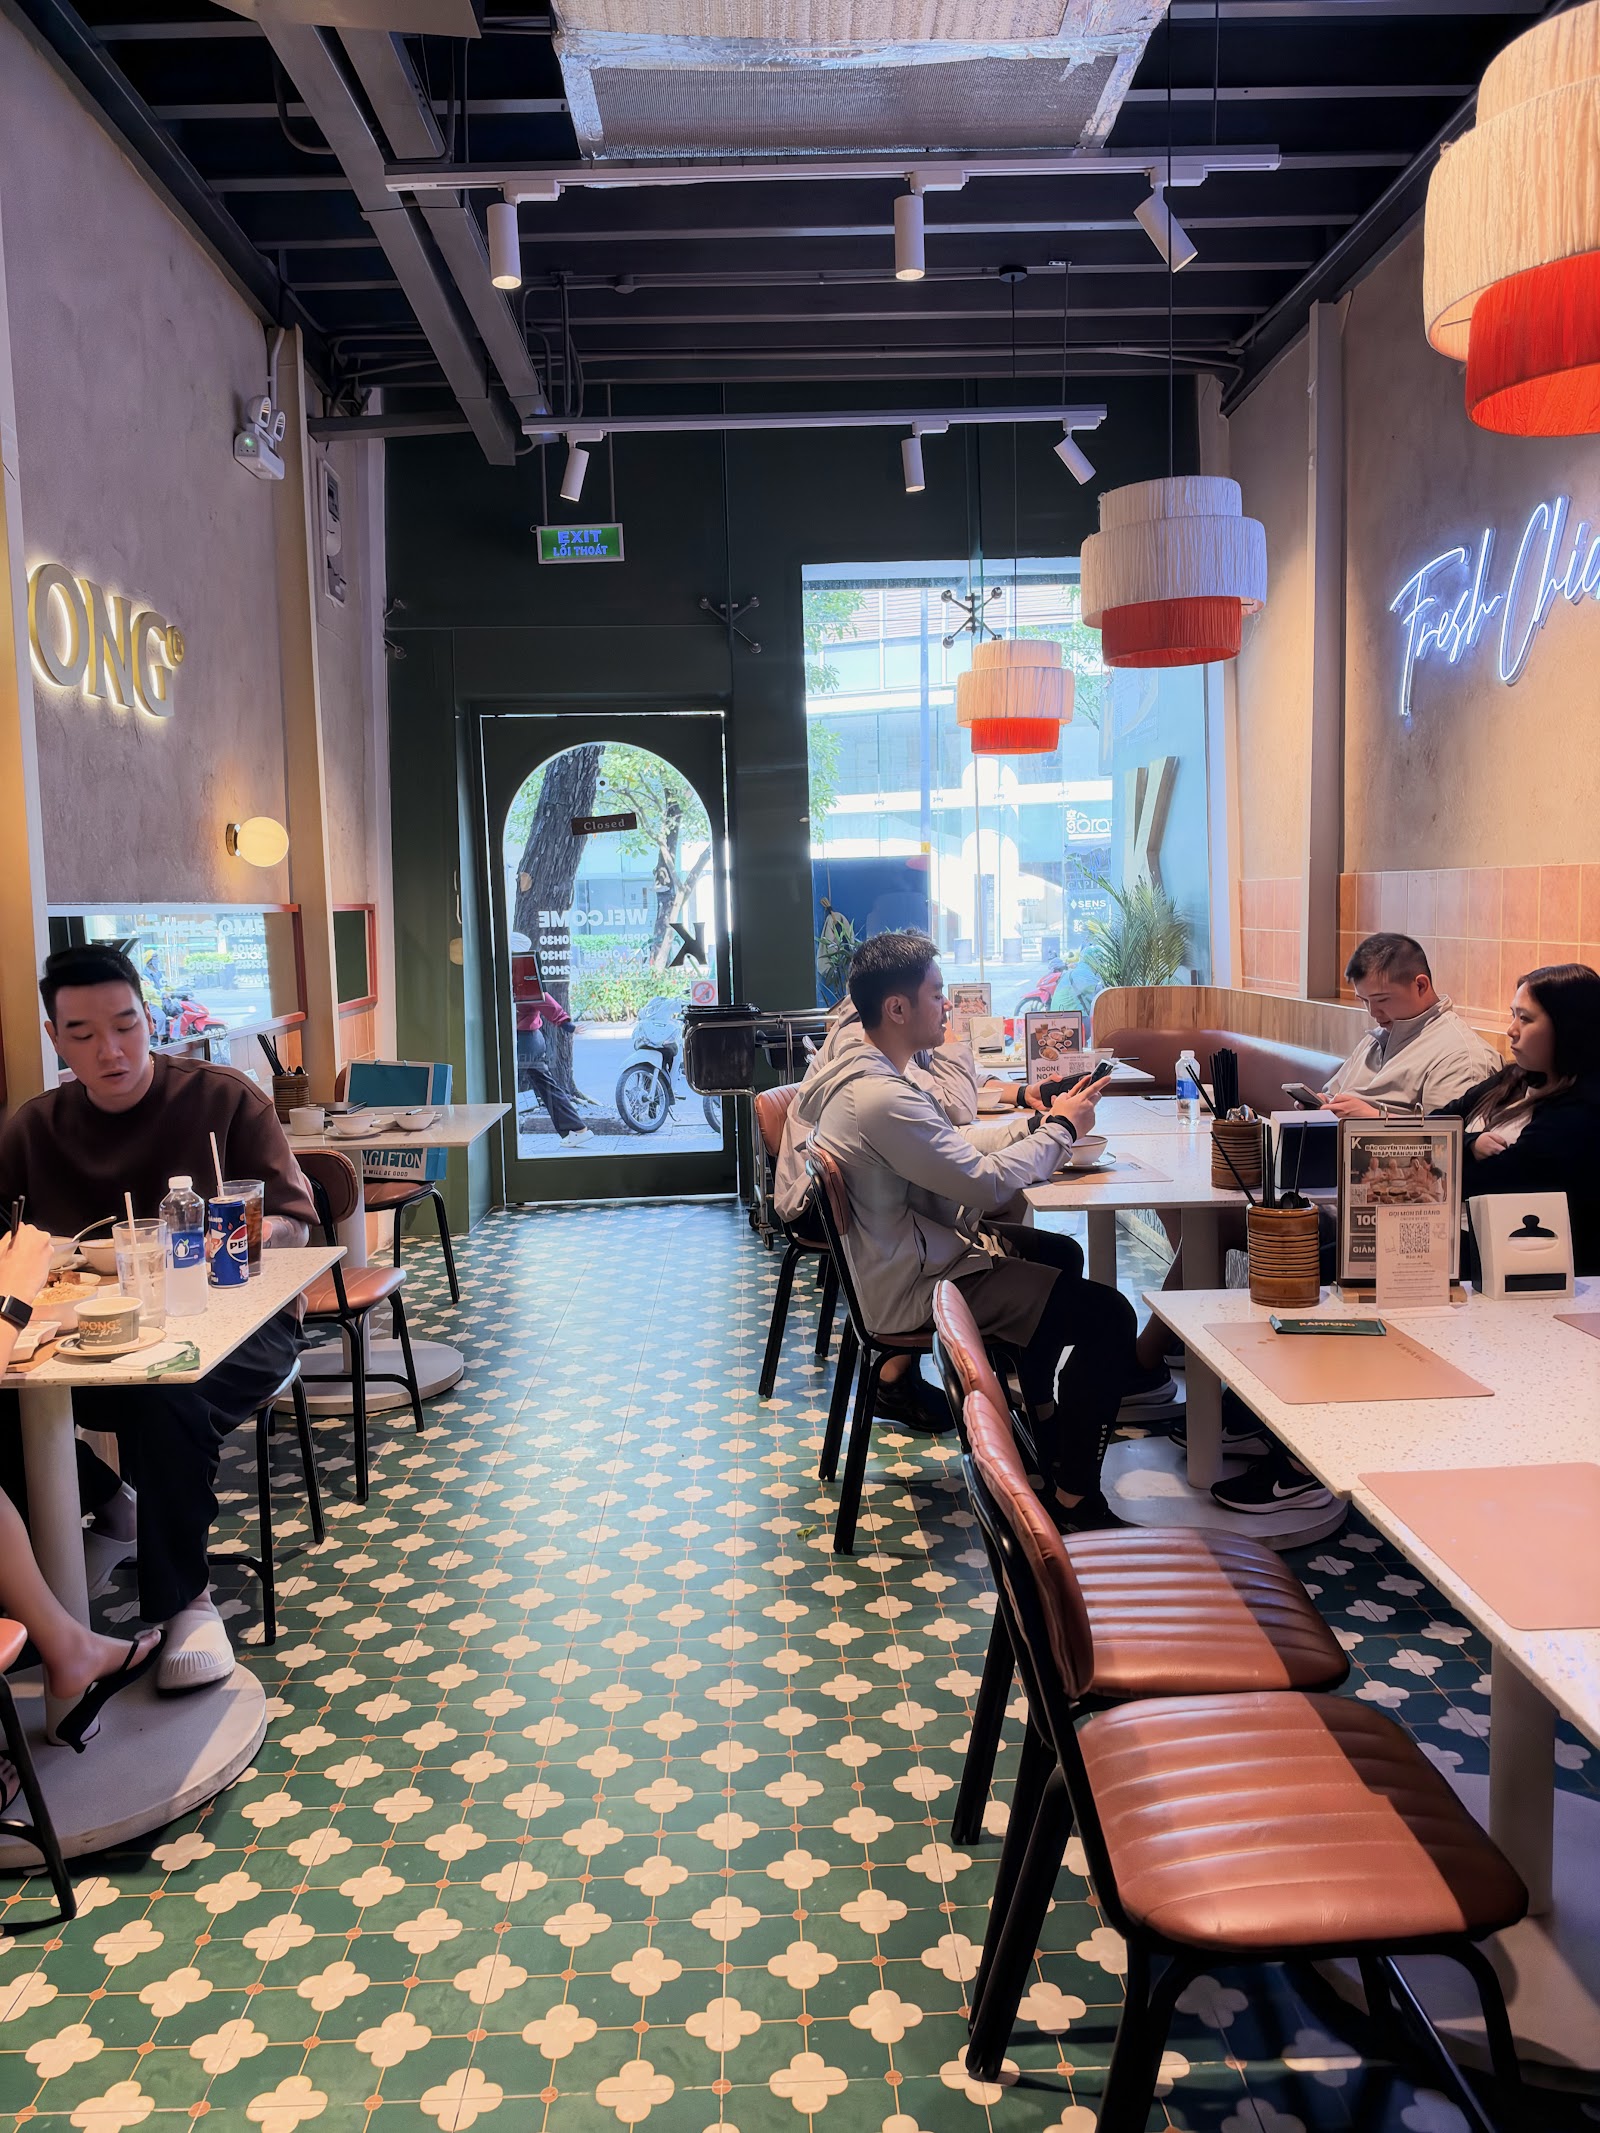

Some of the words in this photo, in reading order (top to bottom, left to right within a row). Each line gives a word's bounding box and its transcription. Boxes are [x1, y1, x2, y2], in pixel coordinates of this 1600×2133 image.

[557, 530, 602, 544] EXIT
[574, 543, 608, 556] THOÁT
[583, 818, 626, 831] Closed
[1078, 899, 1107, 908] SENS
[1351, 1137, 1362, 1150] K
